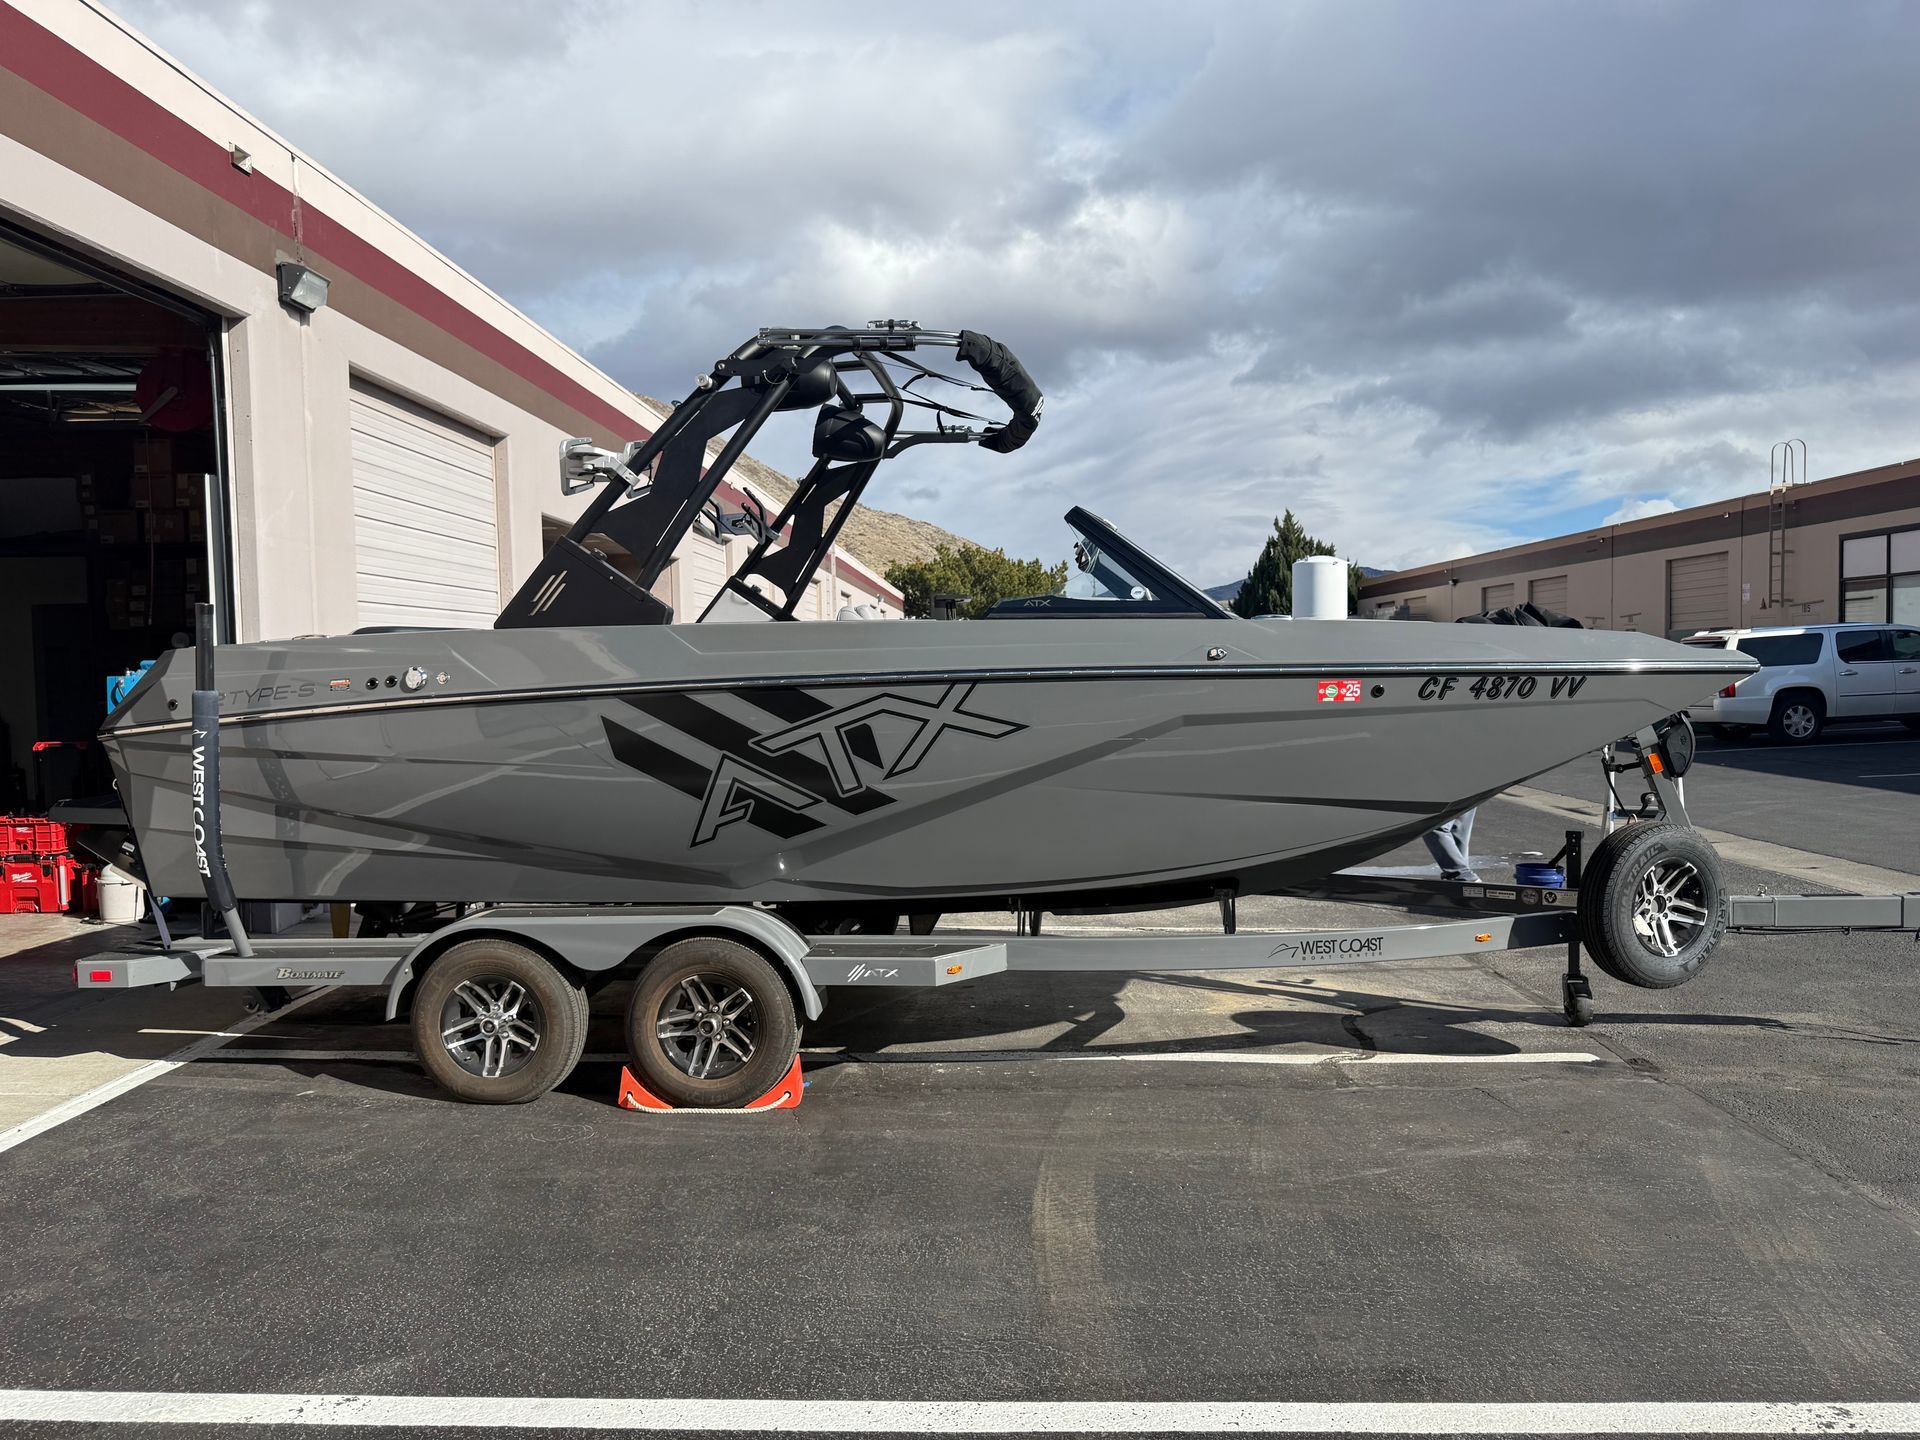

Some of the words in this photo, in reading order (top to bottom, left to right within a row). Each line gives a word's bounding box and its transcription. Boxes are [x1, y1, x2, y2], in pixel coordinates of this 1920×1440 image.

[1023, 599, 1051, 607] ATX
[229, 682, 316, 705] TYPE-S
[1345, 684, 1360, 697] 25
[1417, 676, 1459, 700] CF
[1469, 676, 1538, 700] 4870
[1550, 675, 1587, 699] VV
[192, 745, 205, 806] WEST
[193, 807, 212, 878] COAST
[1300, 940, 1337, 954] WEST
[1339, 937, 1384, 953] COAST
[1340, 951, 1382, 959] CENTER
[864, 968, 899, 977] ATX
